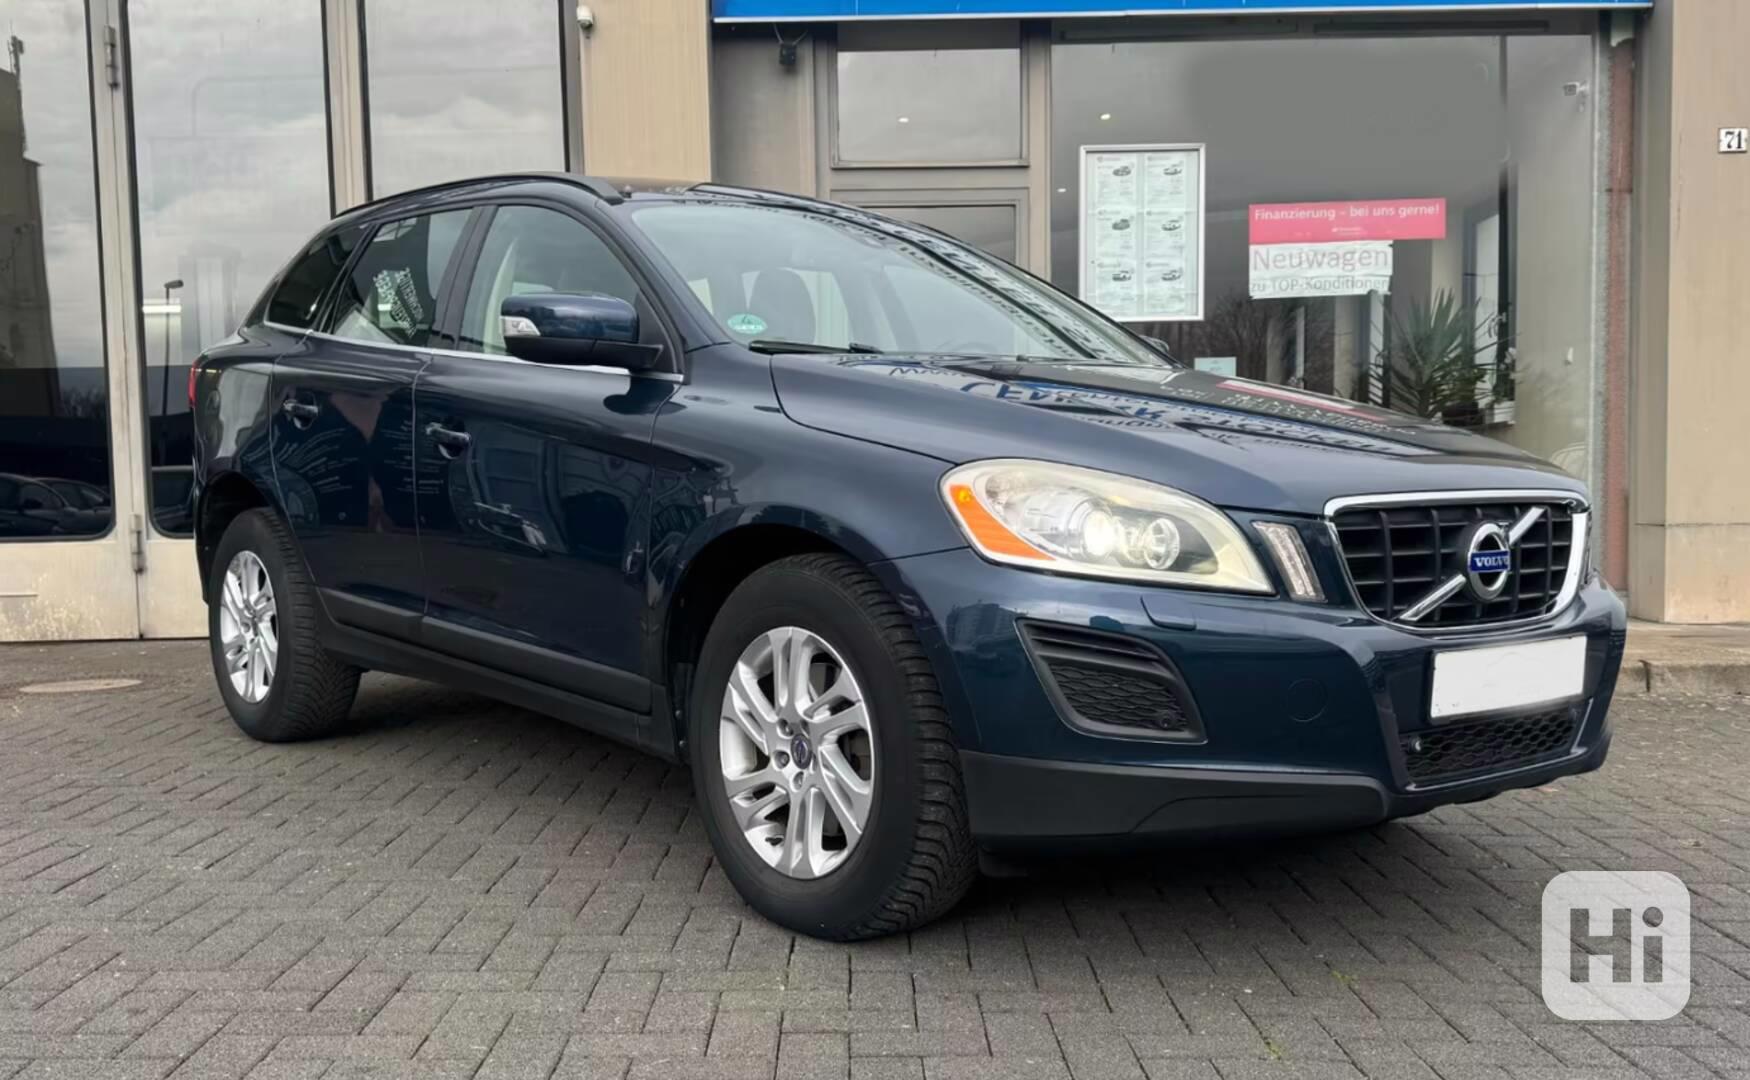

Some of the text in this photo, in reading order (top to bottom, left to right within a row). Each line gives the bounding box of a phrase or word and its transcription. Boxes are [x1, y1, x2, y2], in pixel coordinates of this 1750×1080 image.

[1724, 130, 1743, 149] 71
[1254, 207, 1337, 221] Finanzierung
[1349, 206, 1369, 217] bei
[1372, 206, 1395, 217] uns
[1398, 203, 1440, 217] gerne!
[1253, 247, 1389, 272] Neuwagen
[1251, 282, 1266, 292] zu
